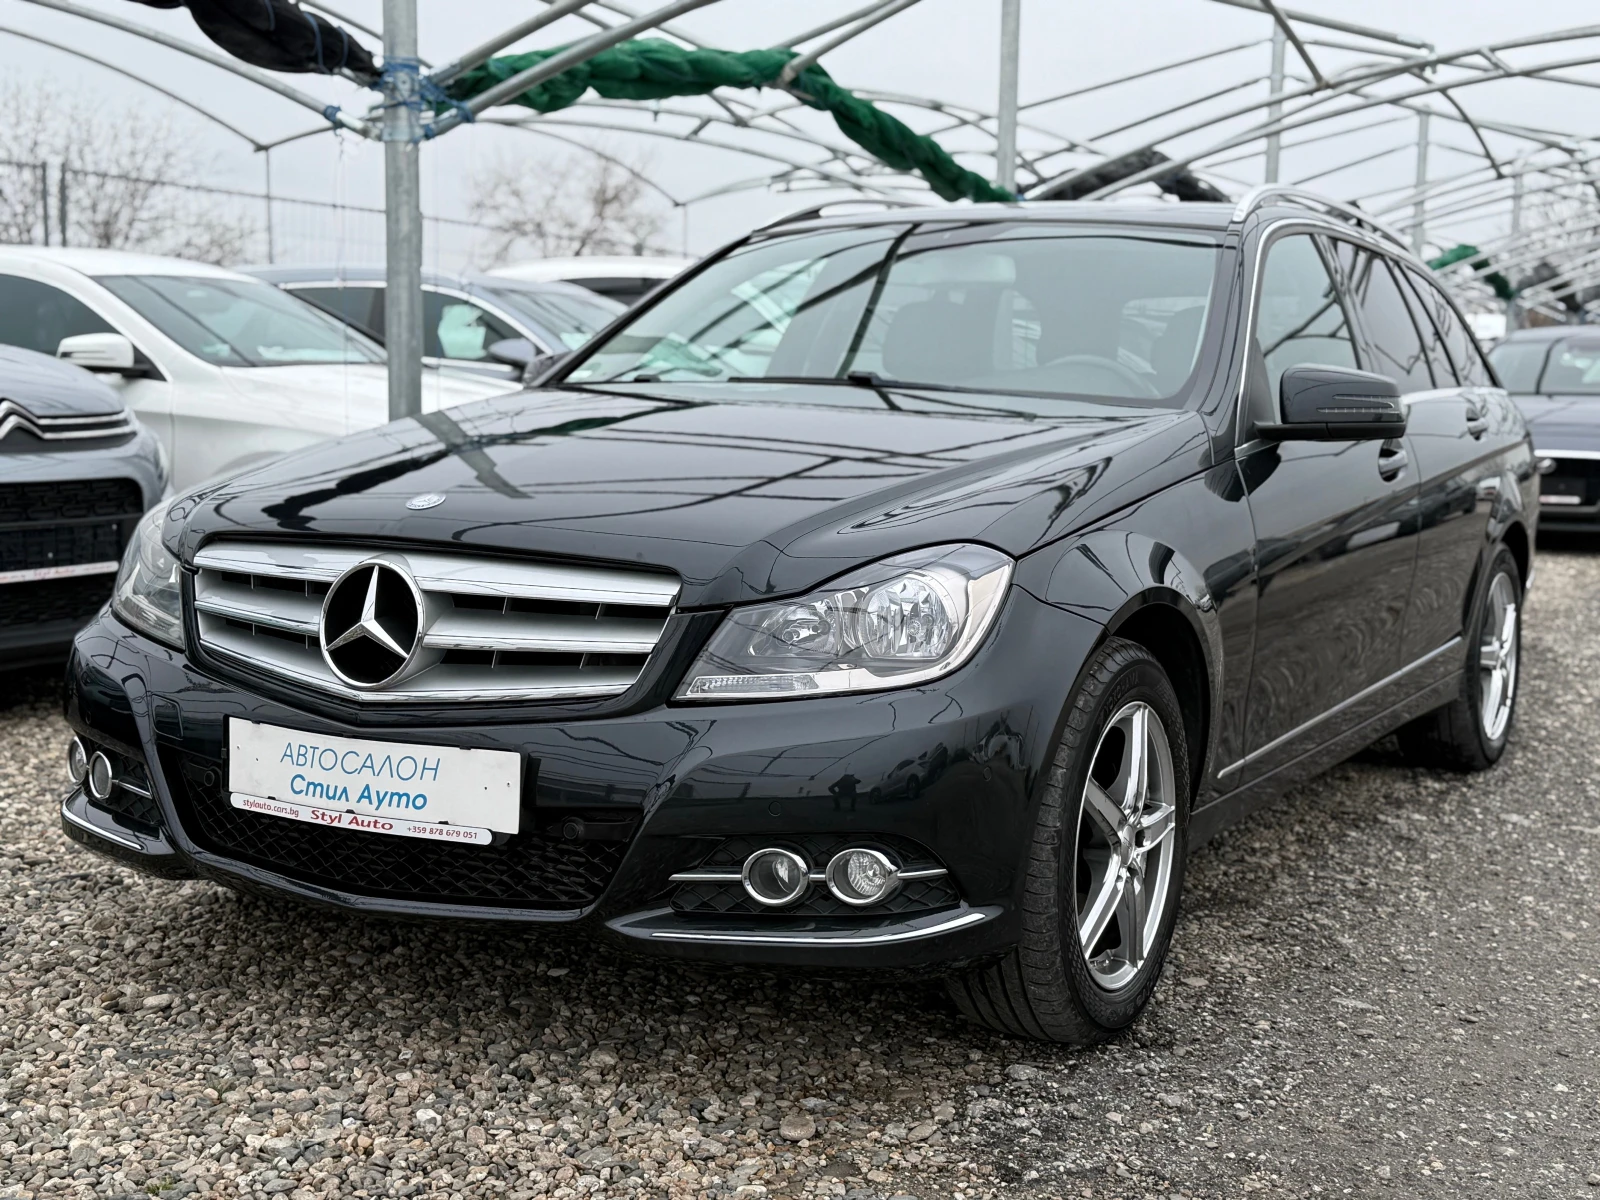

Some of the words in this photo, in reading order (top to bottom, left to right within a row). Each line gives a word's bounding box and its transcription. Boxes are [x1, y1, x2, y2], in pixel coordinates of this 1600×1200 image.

[280, 742, 441, 781] АВТОСАЛОН
[290, 774, 350, 802] Стил
[356, 784, 428, 811] Ауто
[242, 798, 299, 818] stylauto.cars.bg
[310, 809, 343, 825] Styl
[348, 815, 394, 831] Auto
[406, 825, 427, 834] +359
[428, 827, 444, 836] 878
[445, 829, 461, 838] 679
[462, 831, 478, 840] 051
